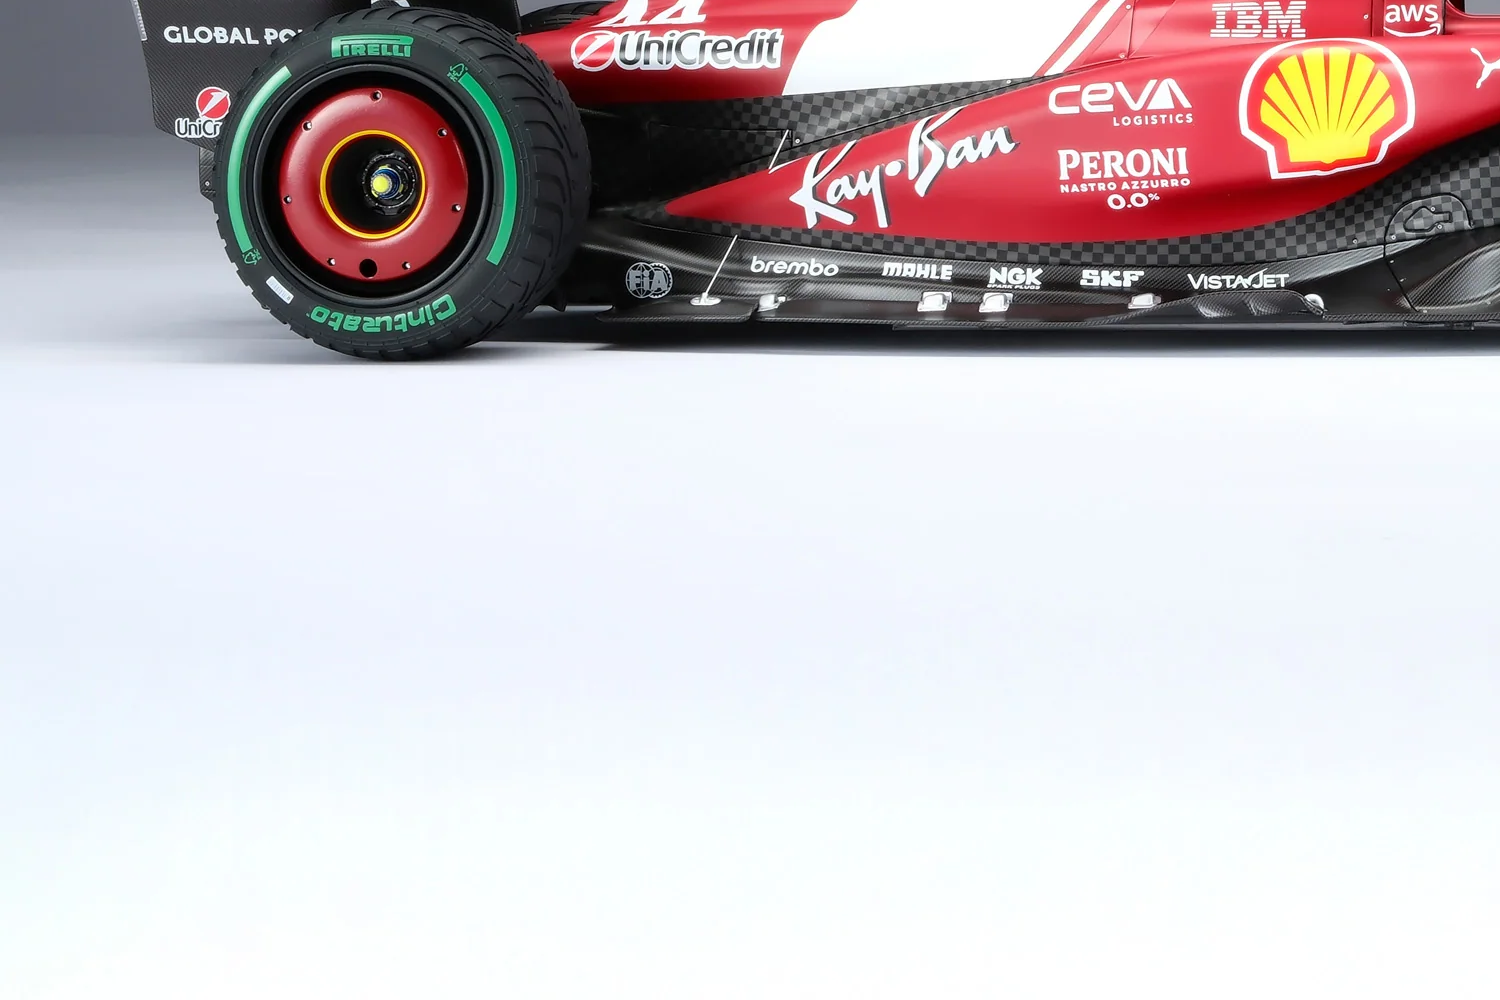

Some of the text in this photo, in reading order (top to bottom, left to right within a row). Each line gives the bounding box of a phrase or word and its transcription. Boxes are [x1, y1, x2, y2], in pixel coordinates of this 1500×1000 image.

[1210, 1, 1306, 38] IBM
[1385, 3, 1439, 23] aws
[164, 26, 259, 44] GLOBAL
[331, 34, 414, 58] PIRELLI
[619, 30, 781, 67] UniCredit
[176, 118, 222, 138] UniCr
[1113, 113, 1193, 126] LOGISTICS
[1057, 147, 1189, 180] PERONI
[1060, 178, 1191, 193] NASTRO AZZURRO
[750, 256, 839, 277] brembo
[882, 262, 953, 280] MAHLE
[989, 267, 1043, 285] NGK
[1080, 269, 1145, 287] SKF
